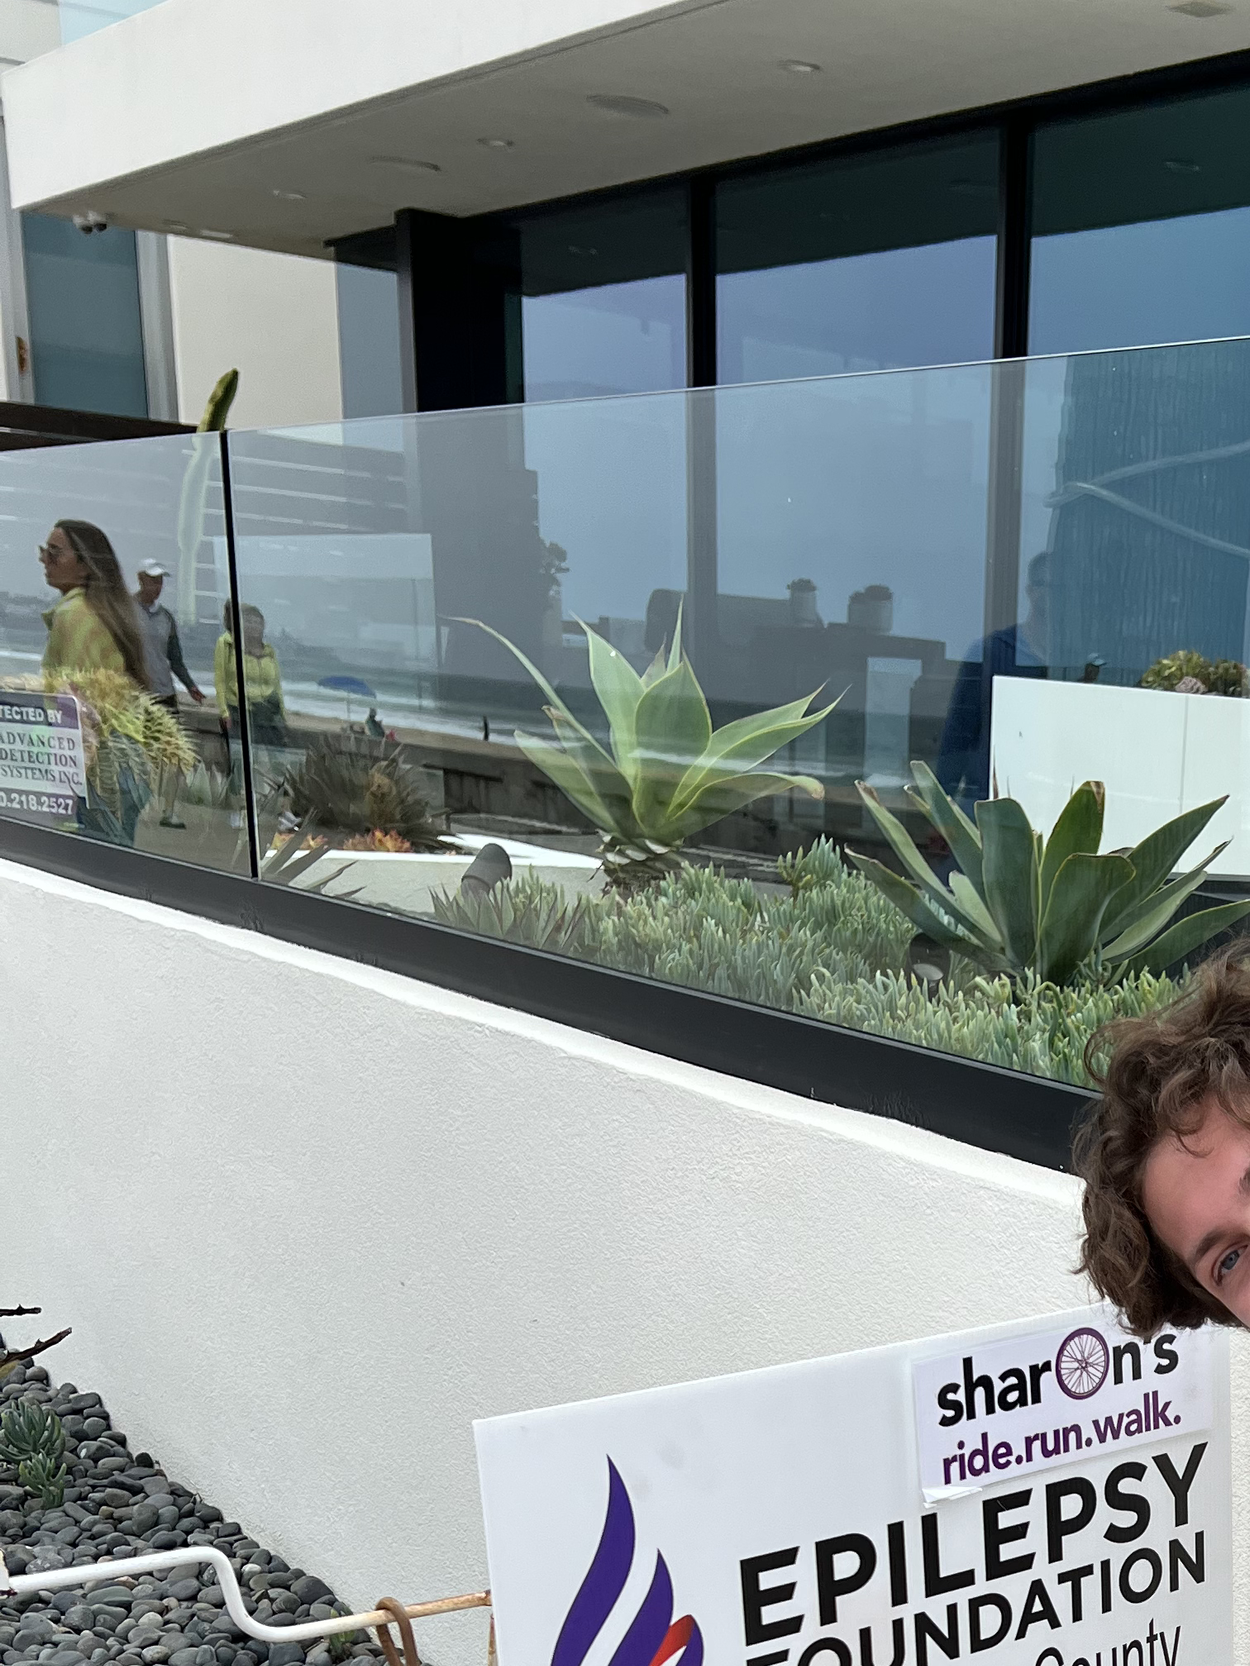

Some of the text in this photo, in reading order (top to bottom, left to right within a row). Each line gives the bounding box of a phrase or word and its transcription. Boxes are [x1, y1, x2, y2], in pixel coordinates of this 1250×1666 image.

[47, 709, 63, 724] BY
[0, 747, 77, 768] DETECTION
[1, 764, 56, 783] SYSTEMS
[942, 1390, 1183, 1486] ride.run.walk.
[739, 1441, 1209, 1646] EPILEPSY
